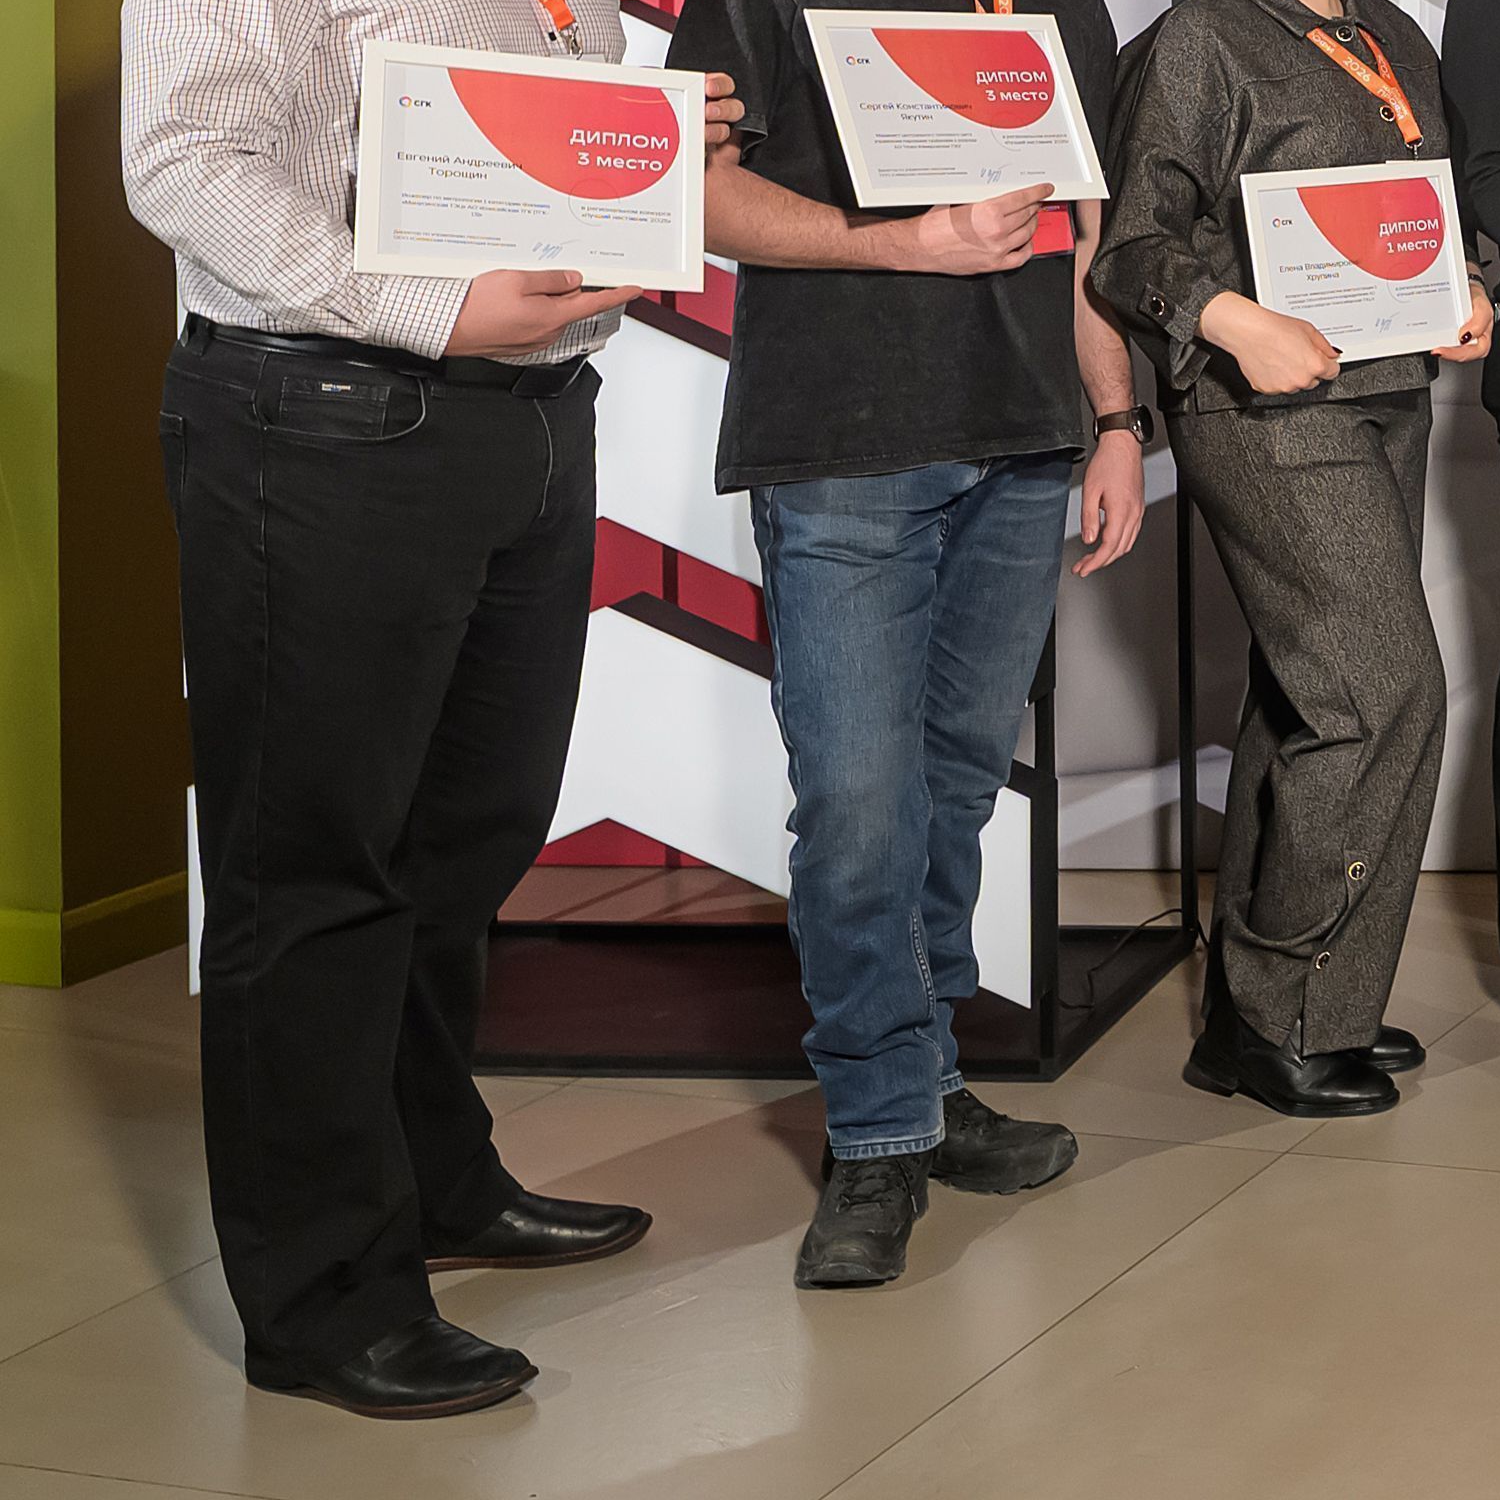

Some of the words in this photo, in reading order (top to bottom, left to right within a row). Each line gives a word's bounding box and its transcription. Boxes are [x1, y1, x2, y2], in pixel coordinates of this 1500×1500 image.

[1343, 56, 1372, 83] 2026
[976, 71, 1047, 84] ДИПЛОМ
[985, 90, 996, 101] 3
[1000, 91, 1048, 101] место
[859, 102, 895, 112] Сергей
[901, 113, 933, 122] Якутин
[569, 128, 669, 150] ДИПЛОМ
[397, 152, 450, 164] Евгений
[454, 155, 523, 171] Андреевич
[577, 152, 590, 166] 3
[596, 155, 663, 172] место
[1379, 218, 1439, 238] ДИПЛОМ
[1386, 242, 1394, 253] 1
[1397, 239, 1438, 252] место
[1279, 261, 1303, 273] Елена
